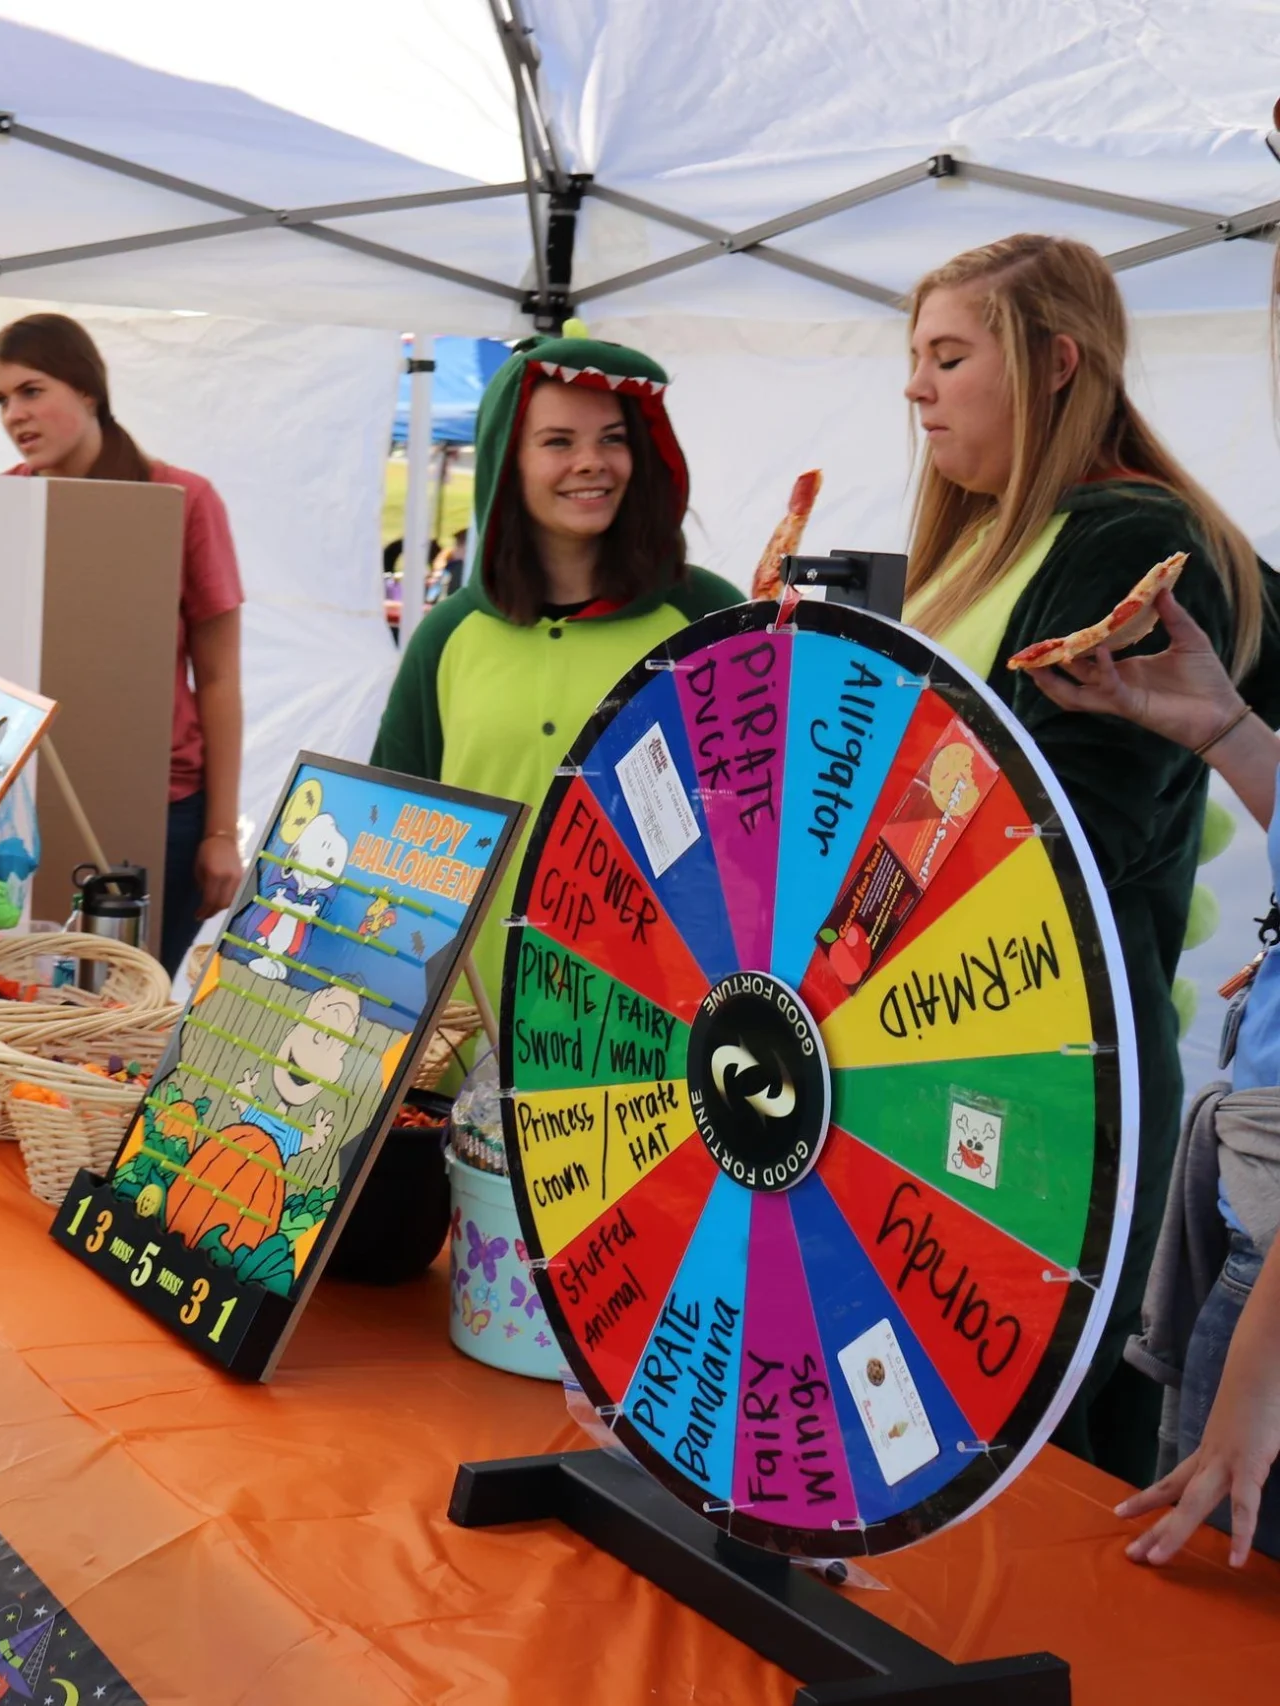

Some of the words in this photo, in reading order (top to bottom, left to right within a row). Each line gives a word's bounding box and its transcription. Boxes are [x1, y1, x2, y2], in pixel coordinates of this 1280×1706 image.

[807, 660, 883, 857] Alligator
[391, 803, 472, 856] HAPPY
[917, 825, 947, 883] Sweet!
[837, 893, 861, 939] Good
[855, 871, 870, 898] for
[864, 839, 884, 875] You!
[702, 975, 774, 1016] FORTUNE
[776, 992, 814, 1056] GOOD
[515, 1018, 583, 1071] Sword
[609, 1039, 666, 1082] WAND
[517, 1102, 595, 1152] Princess
[628, 1122, 670, 1171] HAT
[691, 1089, 756, 1185] FORTUNE
[762, 1140, 809, 1186] GOOD
[67, 1195, 93, 1236] 1
[85, 1209, 114, 1253] 3
[108, 1236, 135, 1264] MISS!
[130, 1241, 162, 1288] 5
[156, 1267, 184, 1296] MISS!
[179, 1277, 211, 1325] 3
[207, 1297, 239, 1344] 1
[583, 1266, 648, 1352] Animal
[672, 1298, 741, 1483] Bandana
